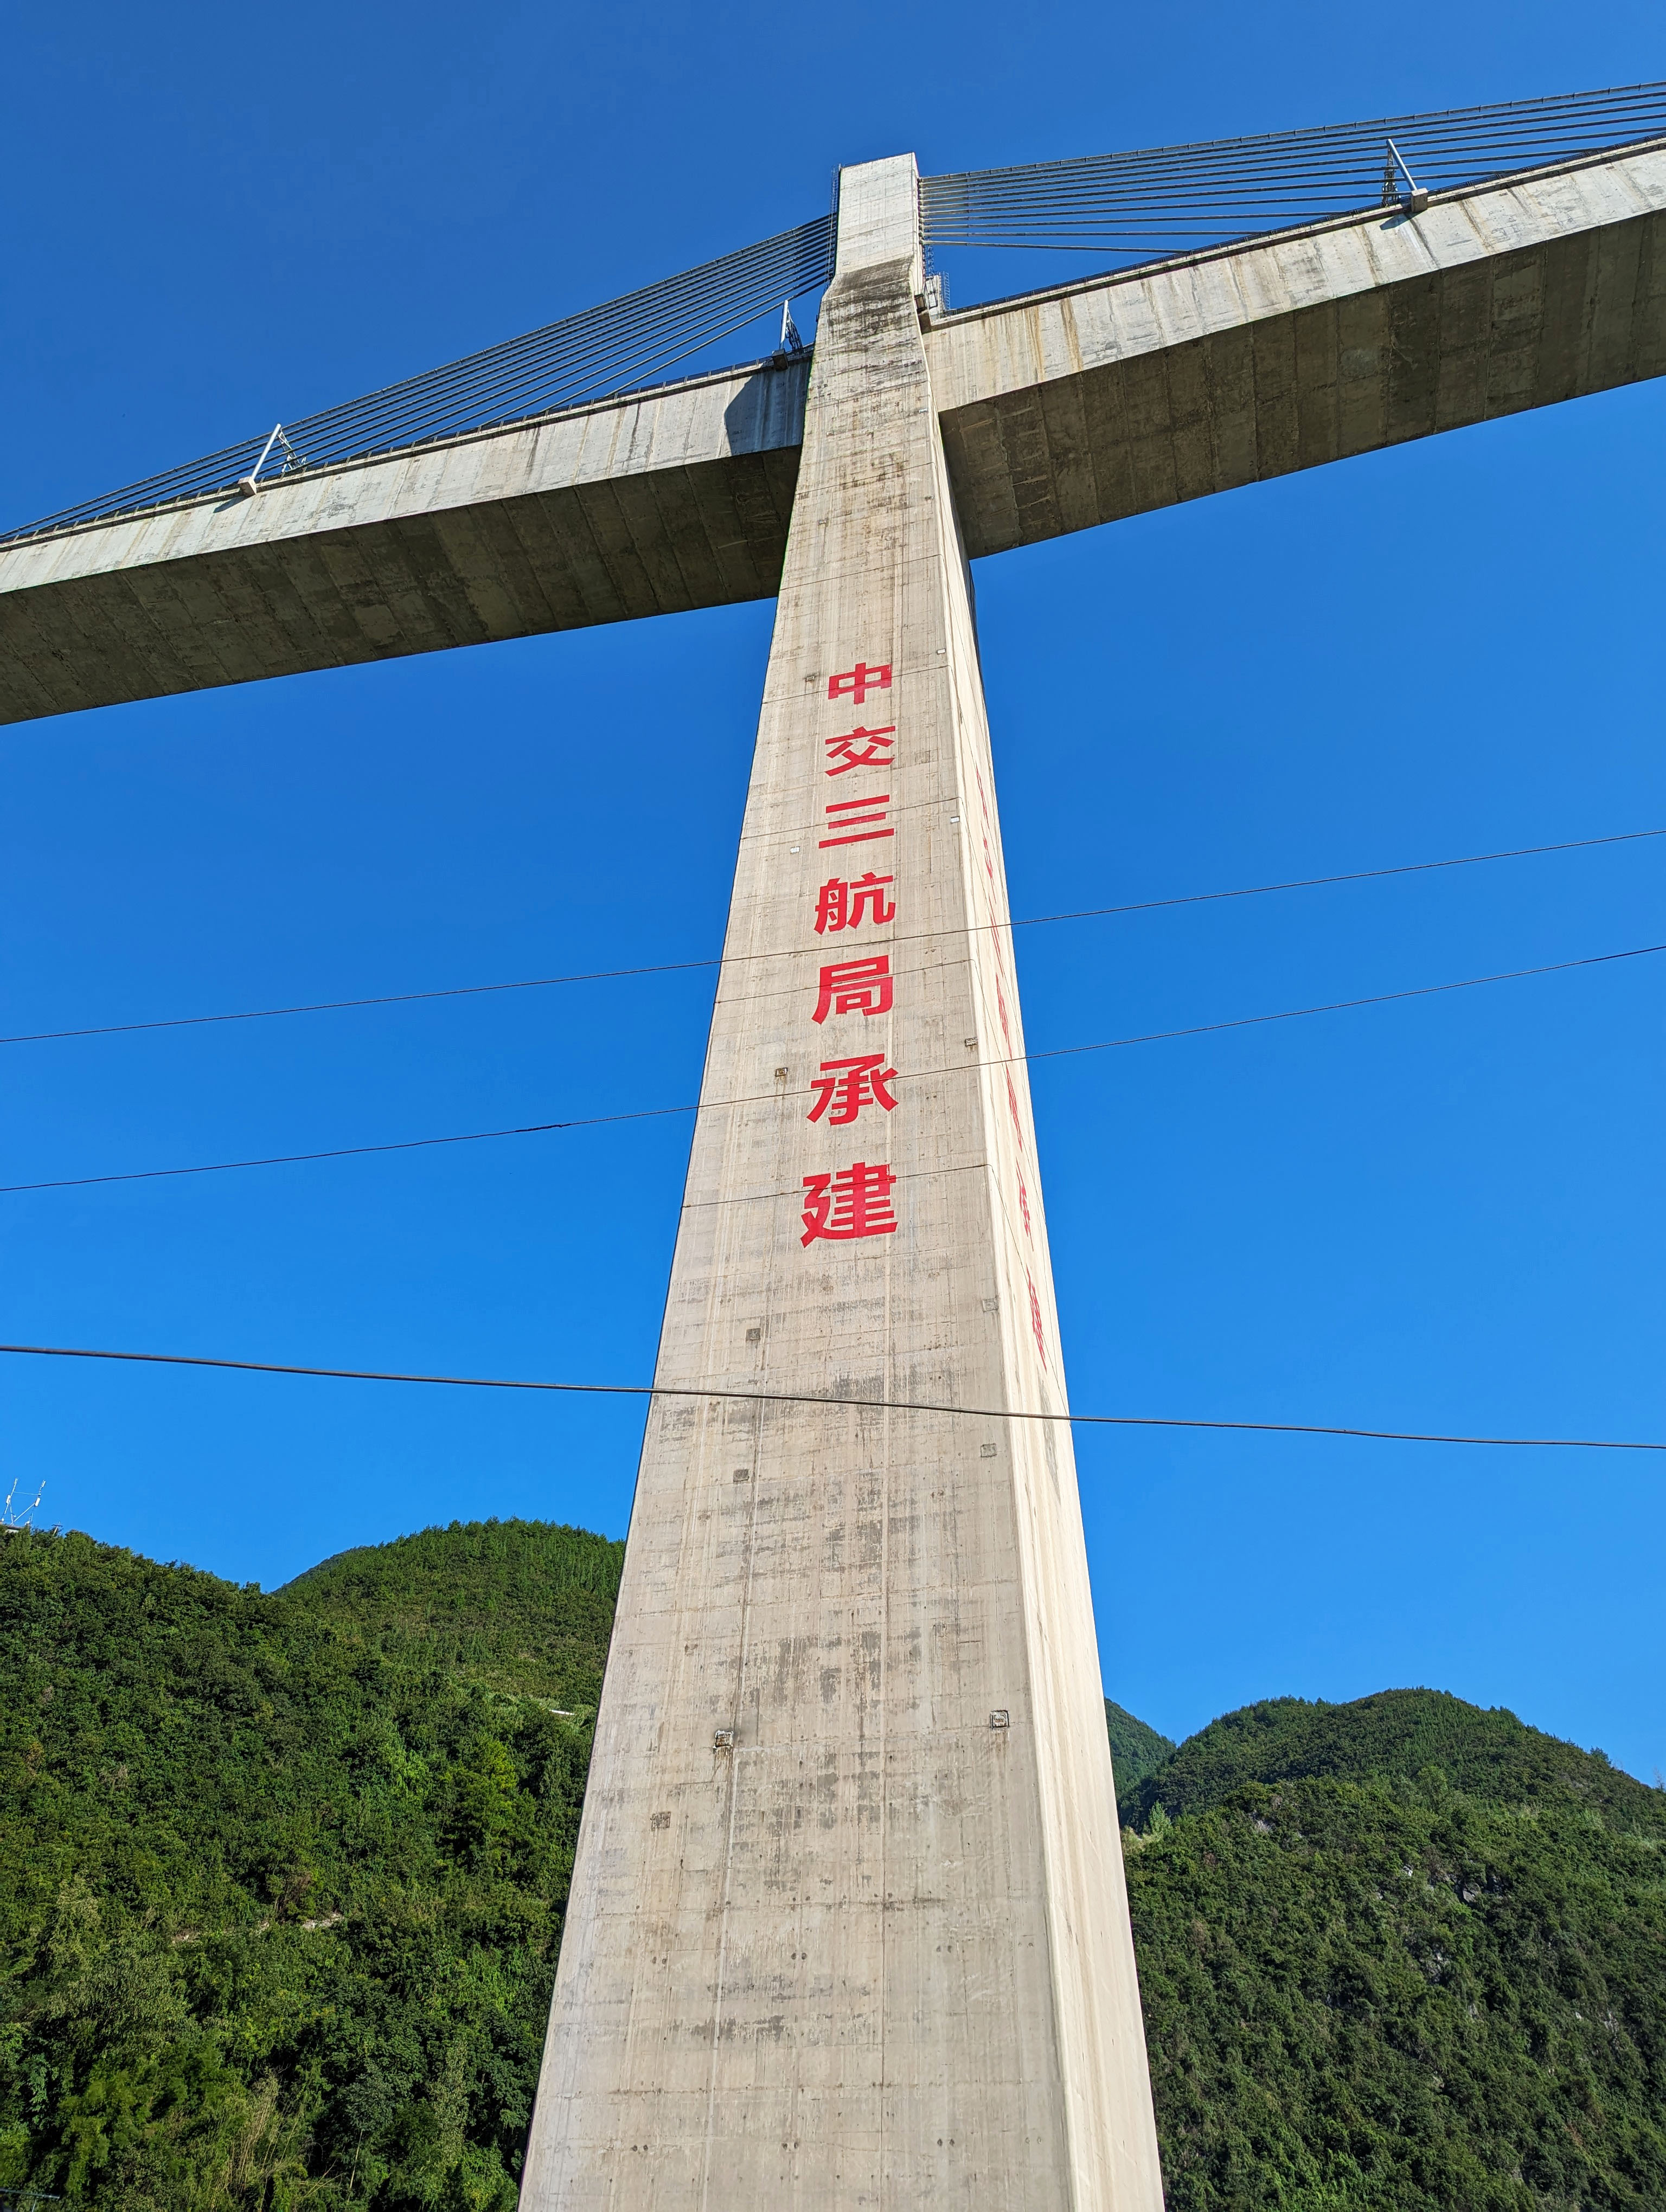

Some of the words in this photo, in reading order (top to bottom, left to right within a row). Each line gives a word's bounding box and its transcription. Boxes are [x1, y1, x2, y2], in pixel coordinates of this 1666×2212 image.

[800, 662, 899, 1248] 中交三航局承建
